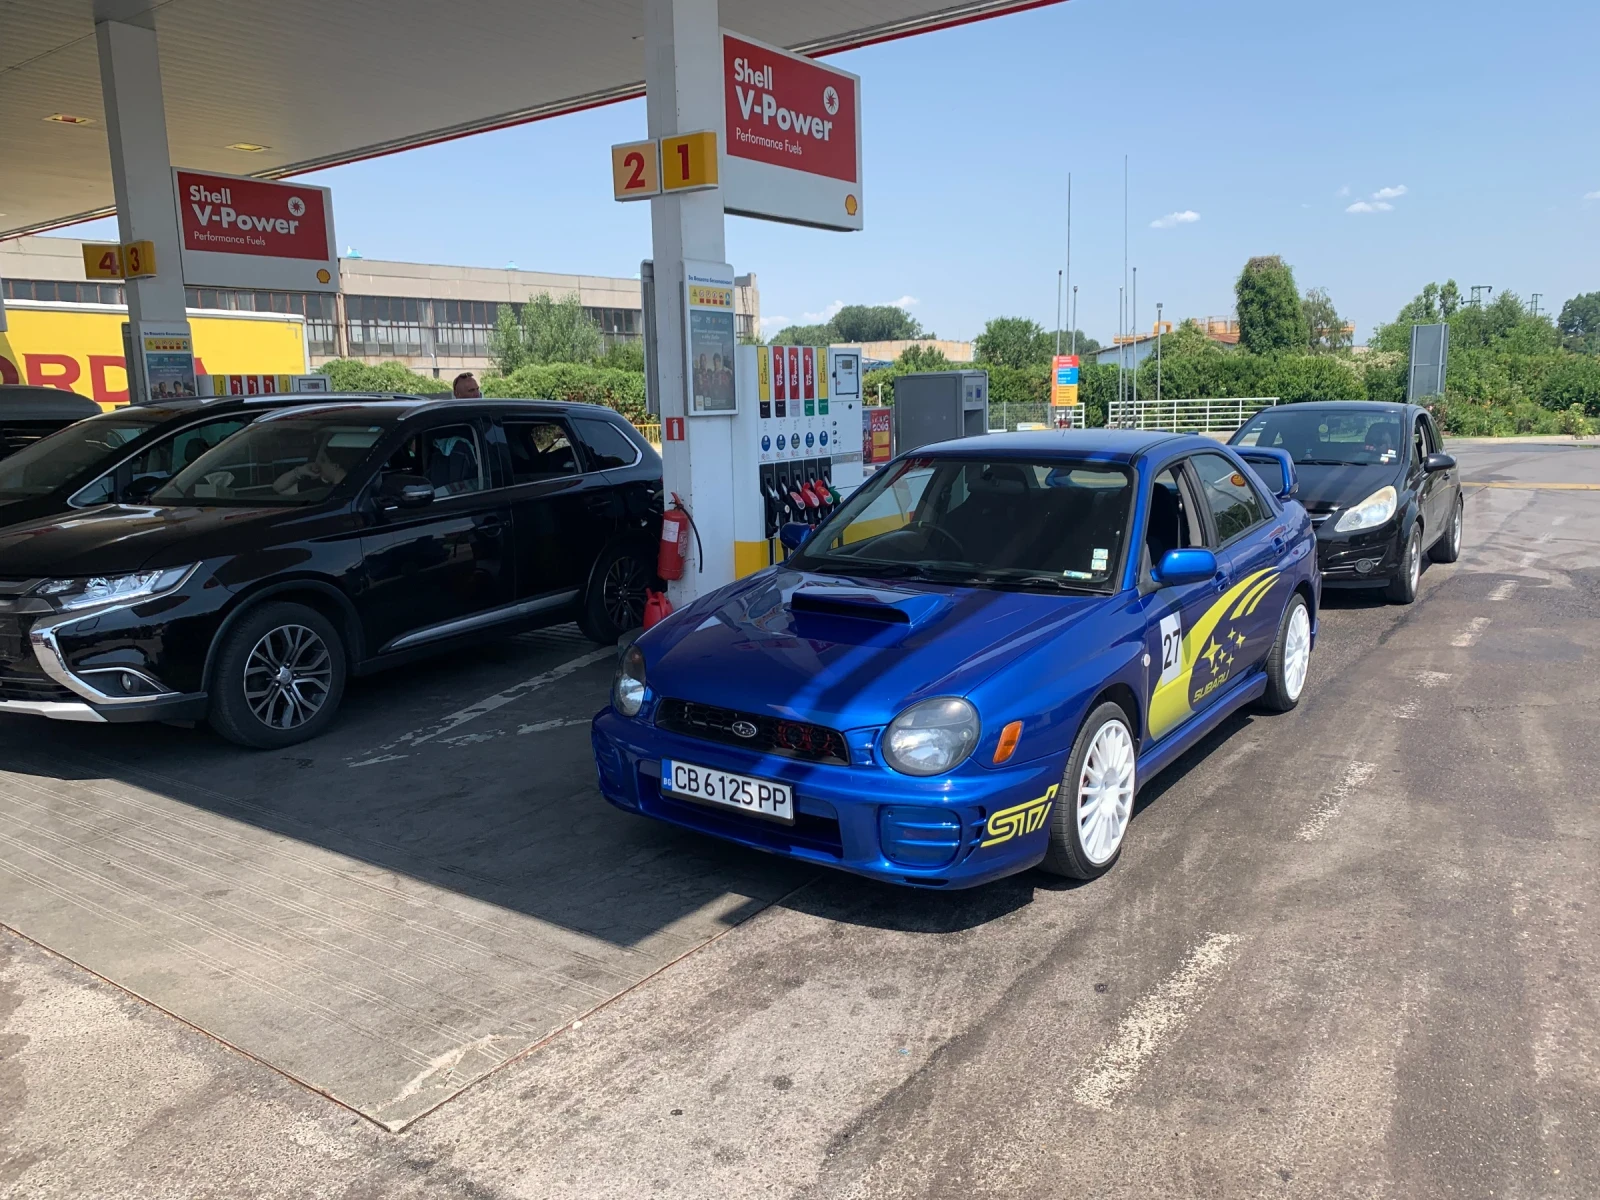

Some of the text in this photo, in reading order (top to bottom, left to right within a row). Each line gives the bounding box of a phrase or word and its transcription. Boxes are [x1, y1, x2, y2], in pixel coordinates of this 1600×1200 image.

[733, 57, 773, 91] Shell
[735, 85, 833, 141] V-Power
[736, 127, 803, 156] Performance Fuels
[623, 151, 646, 190] 2
[677, 143, 690, 181] 1
[190, 185, 232, 205] Shell
[191, 203, 300, 235] V-Power
[194, 231, 266, 246] Performance Fuels
[98, 251, 119, 275] 4
[130, 247, 140, 272] 3
[1163, 627, 1181, 671] 27
[1192, 669, 1230, 703] SUBARU
[663, 777, 672, 787] BG
[675, 765, 787, 812] CB 6125 PP
